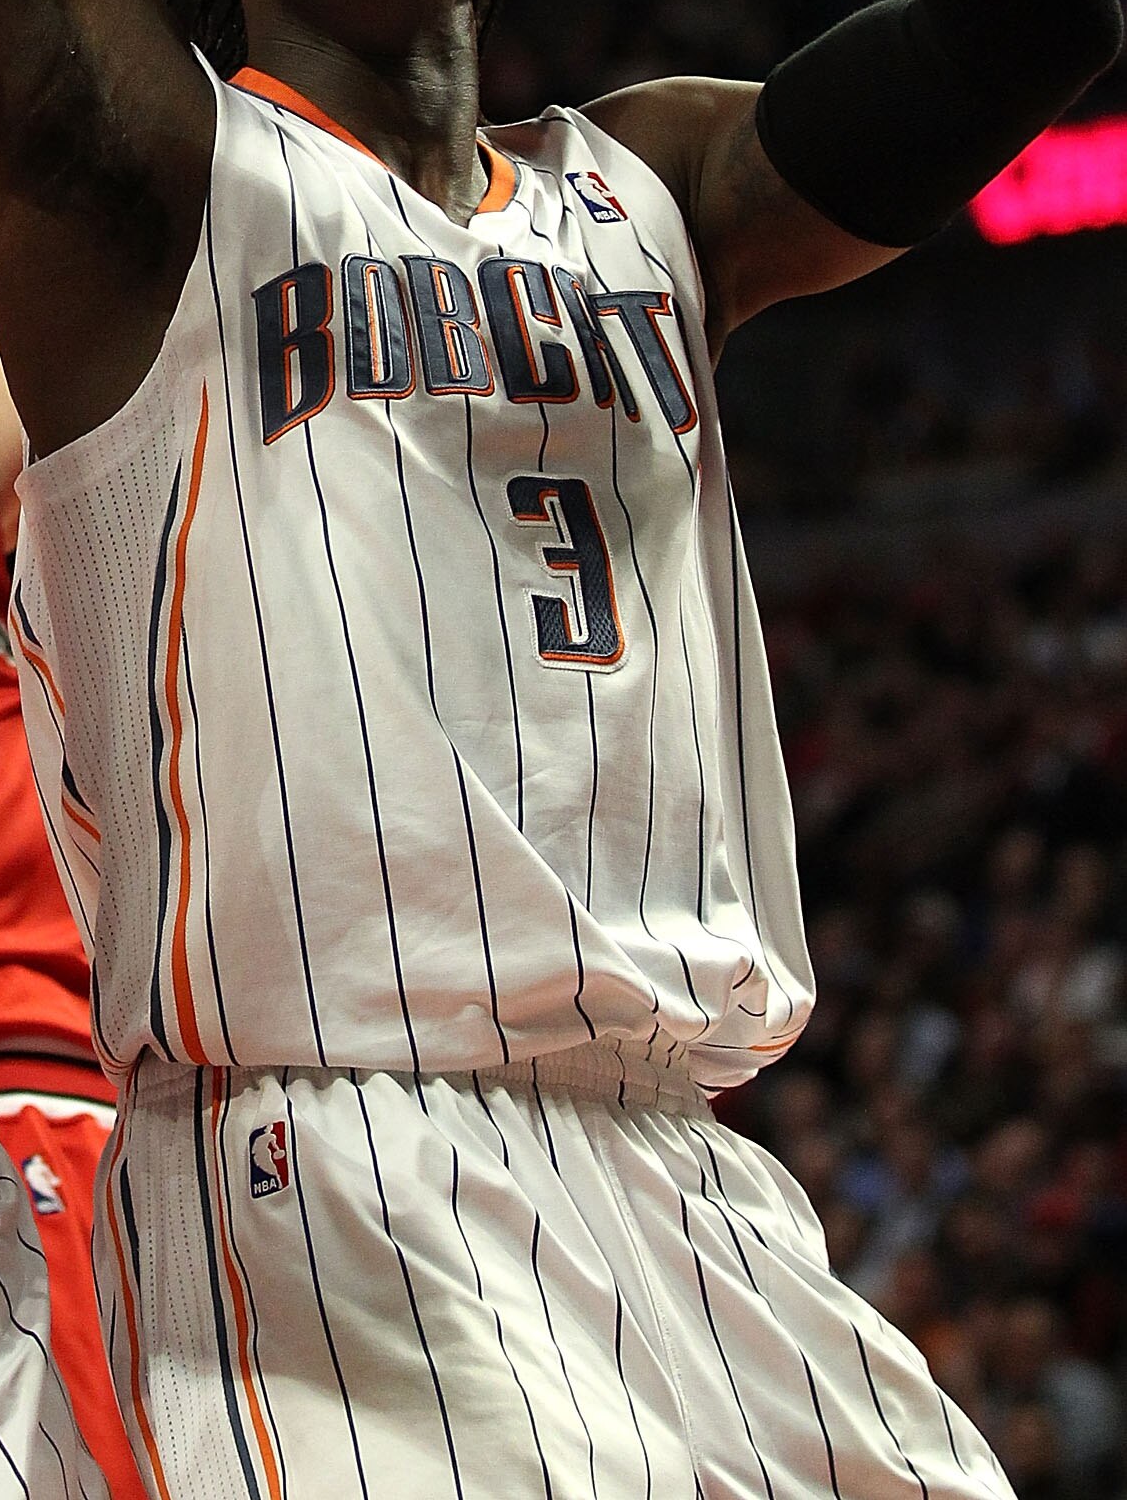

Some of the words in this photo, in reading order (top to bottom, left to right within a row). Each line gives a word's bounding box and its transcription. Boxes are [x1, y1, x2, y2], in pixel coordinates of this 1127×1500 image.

[593, 210, 619, 221] NBA
[251, 253, 699, 446] BOBCAT
[506, 474, 625, 667] 3
[254, 1178, 277, 1194] NBA
